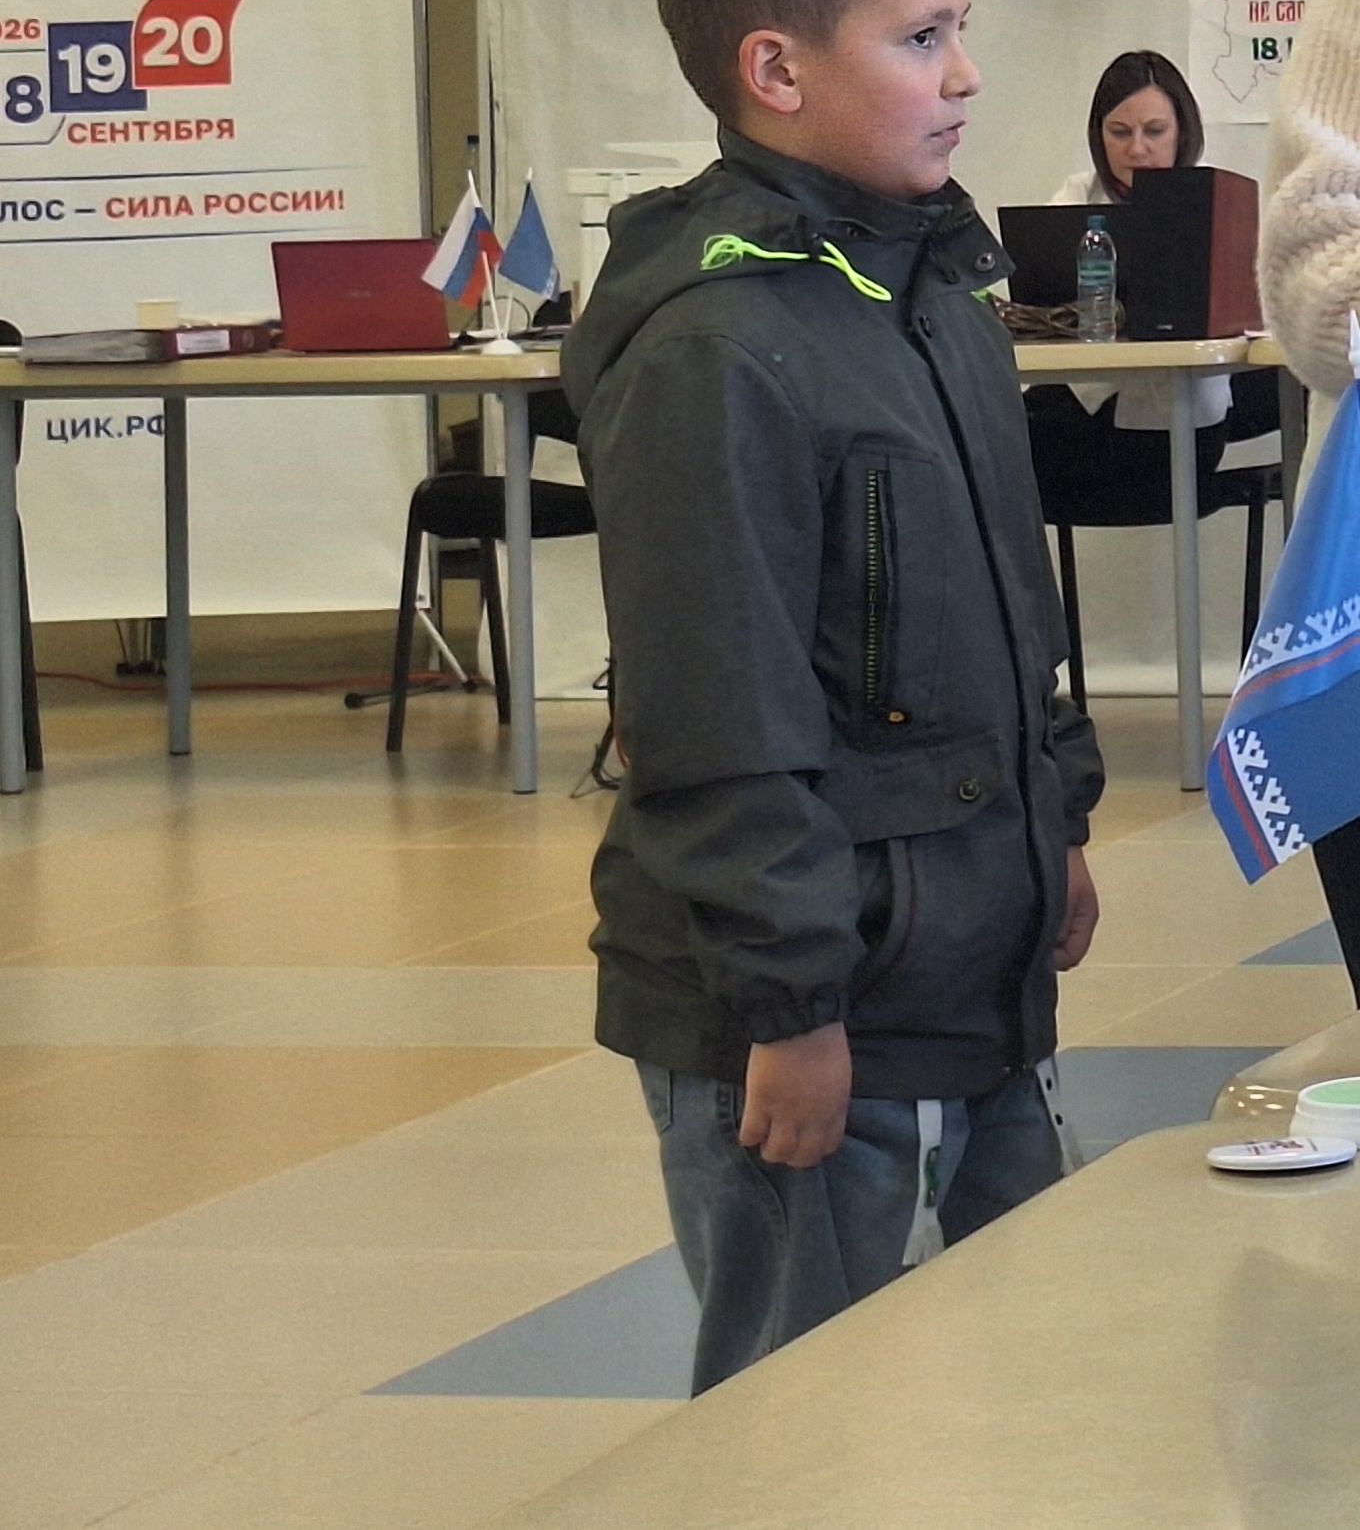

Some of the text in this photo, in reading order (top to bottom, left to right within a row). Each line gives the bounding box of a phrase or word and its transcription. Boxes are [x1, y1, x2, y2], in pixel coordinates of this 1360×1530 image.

[1249, 1, 1270, 22] НЕ
[142, 15, 223, 67] 20
[57, 42, 126, 94] 19
[67, 118, 235, 144] СЕНТЯБРЯ
[0, 199, 65, 221] ЛОС
[105, 194, 194, 219] СИЛА
[203, 189, 345, 216] РОССИИ!
[46, 414, 165, 444] ЦИК.РФ
